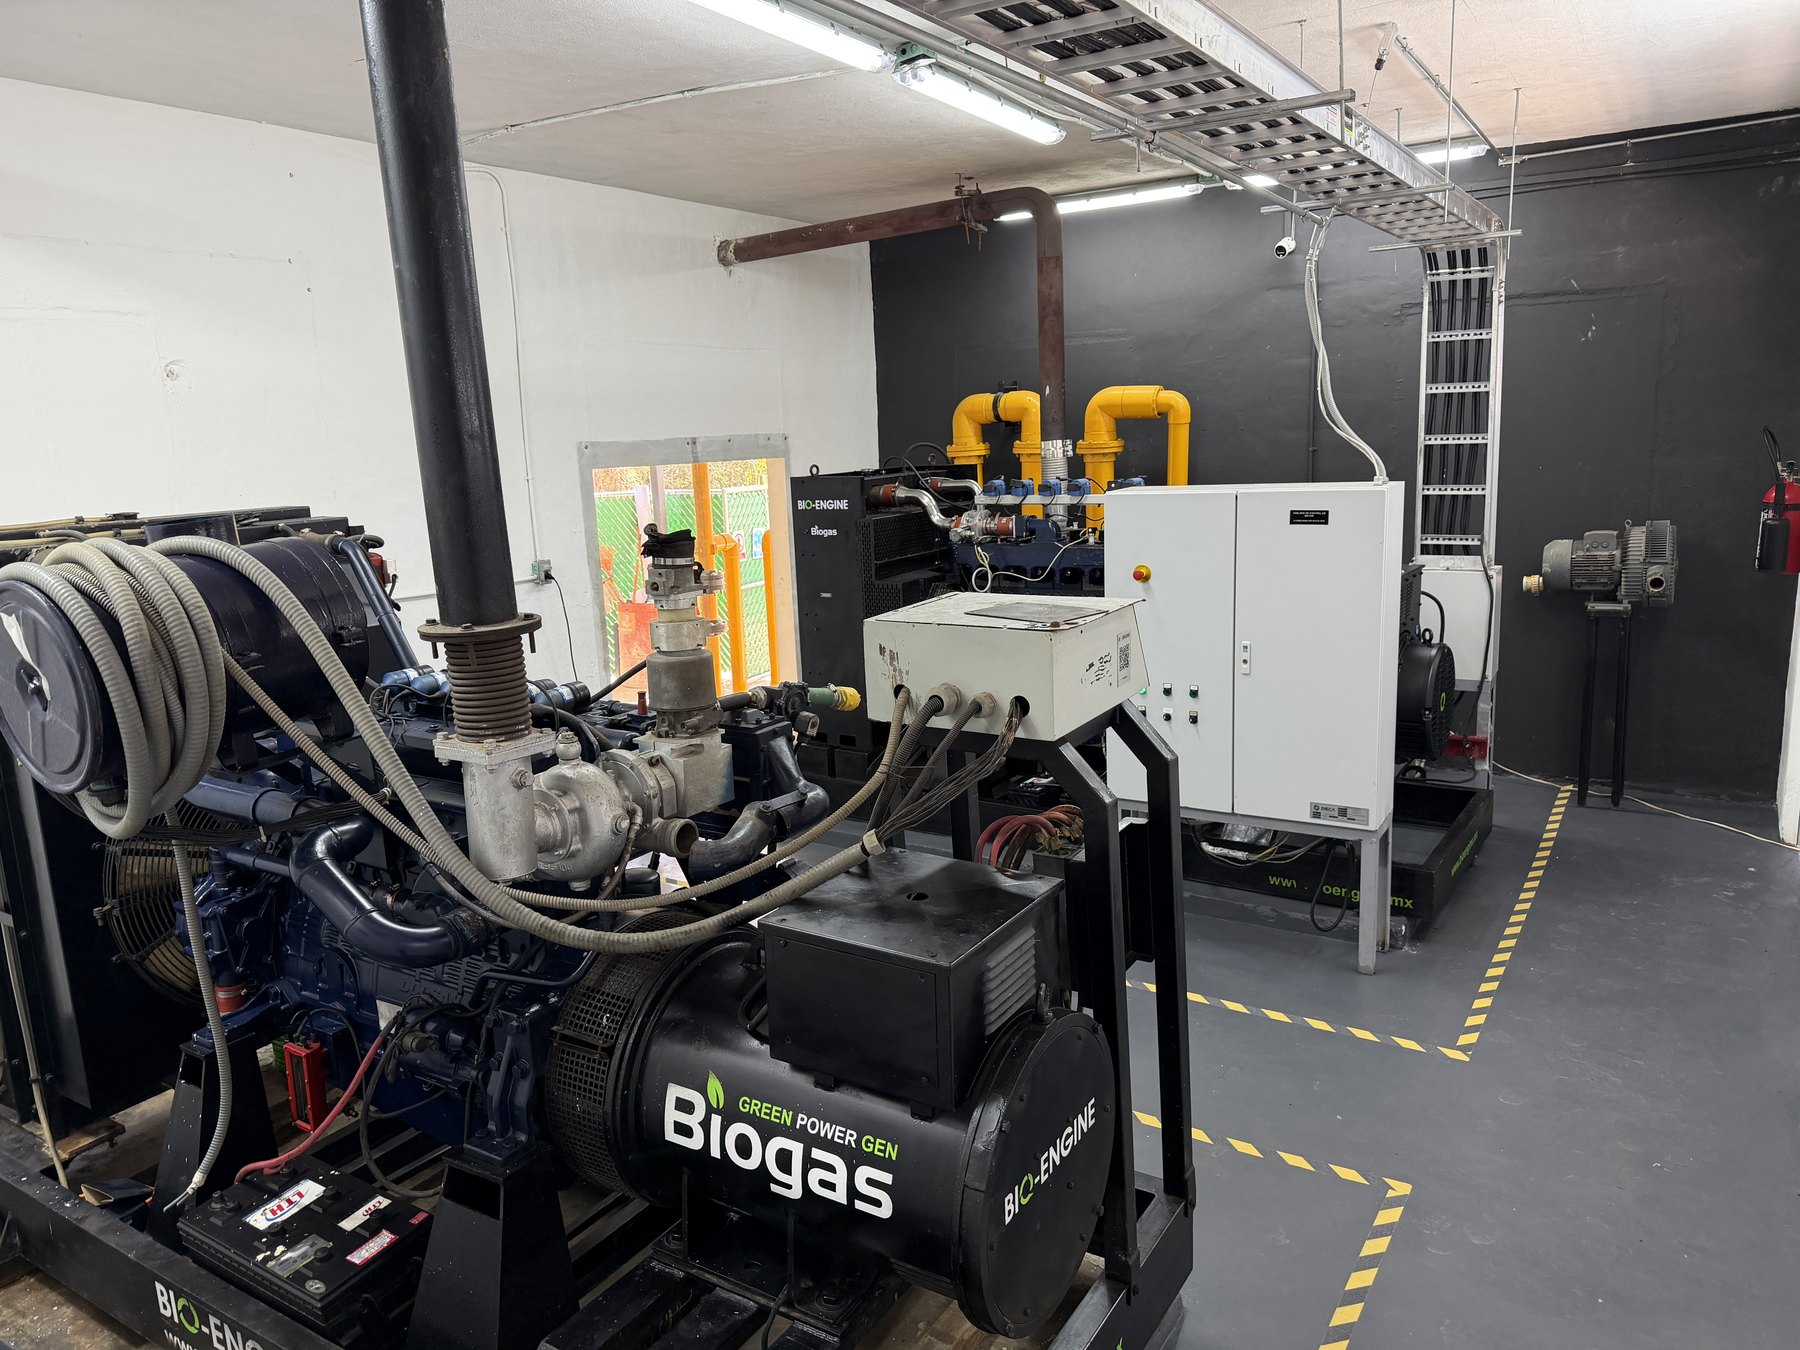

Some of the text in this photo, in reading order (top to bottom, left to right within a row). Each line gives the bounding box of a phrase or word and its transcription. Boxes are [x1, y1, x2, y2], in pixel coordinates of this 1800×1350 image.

[797, 499, 849, 510] BIO-ENGINE
[810, 525, 838, 538] Biogas
[664, 1070, 894, 1220] Biogas
[738, 1096, 899, 1161] GREEN POWER GEN
[1004, 1097, 1096, 1226] BIO-ENGINE
[269, 1190, 305, 1217] LTH
